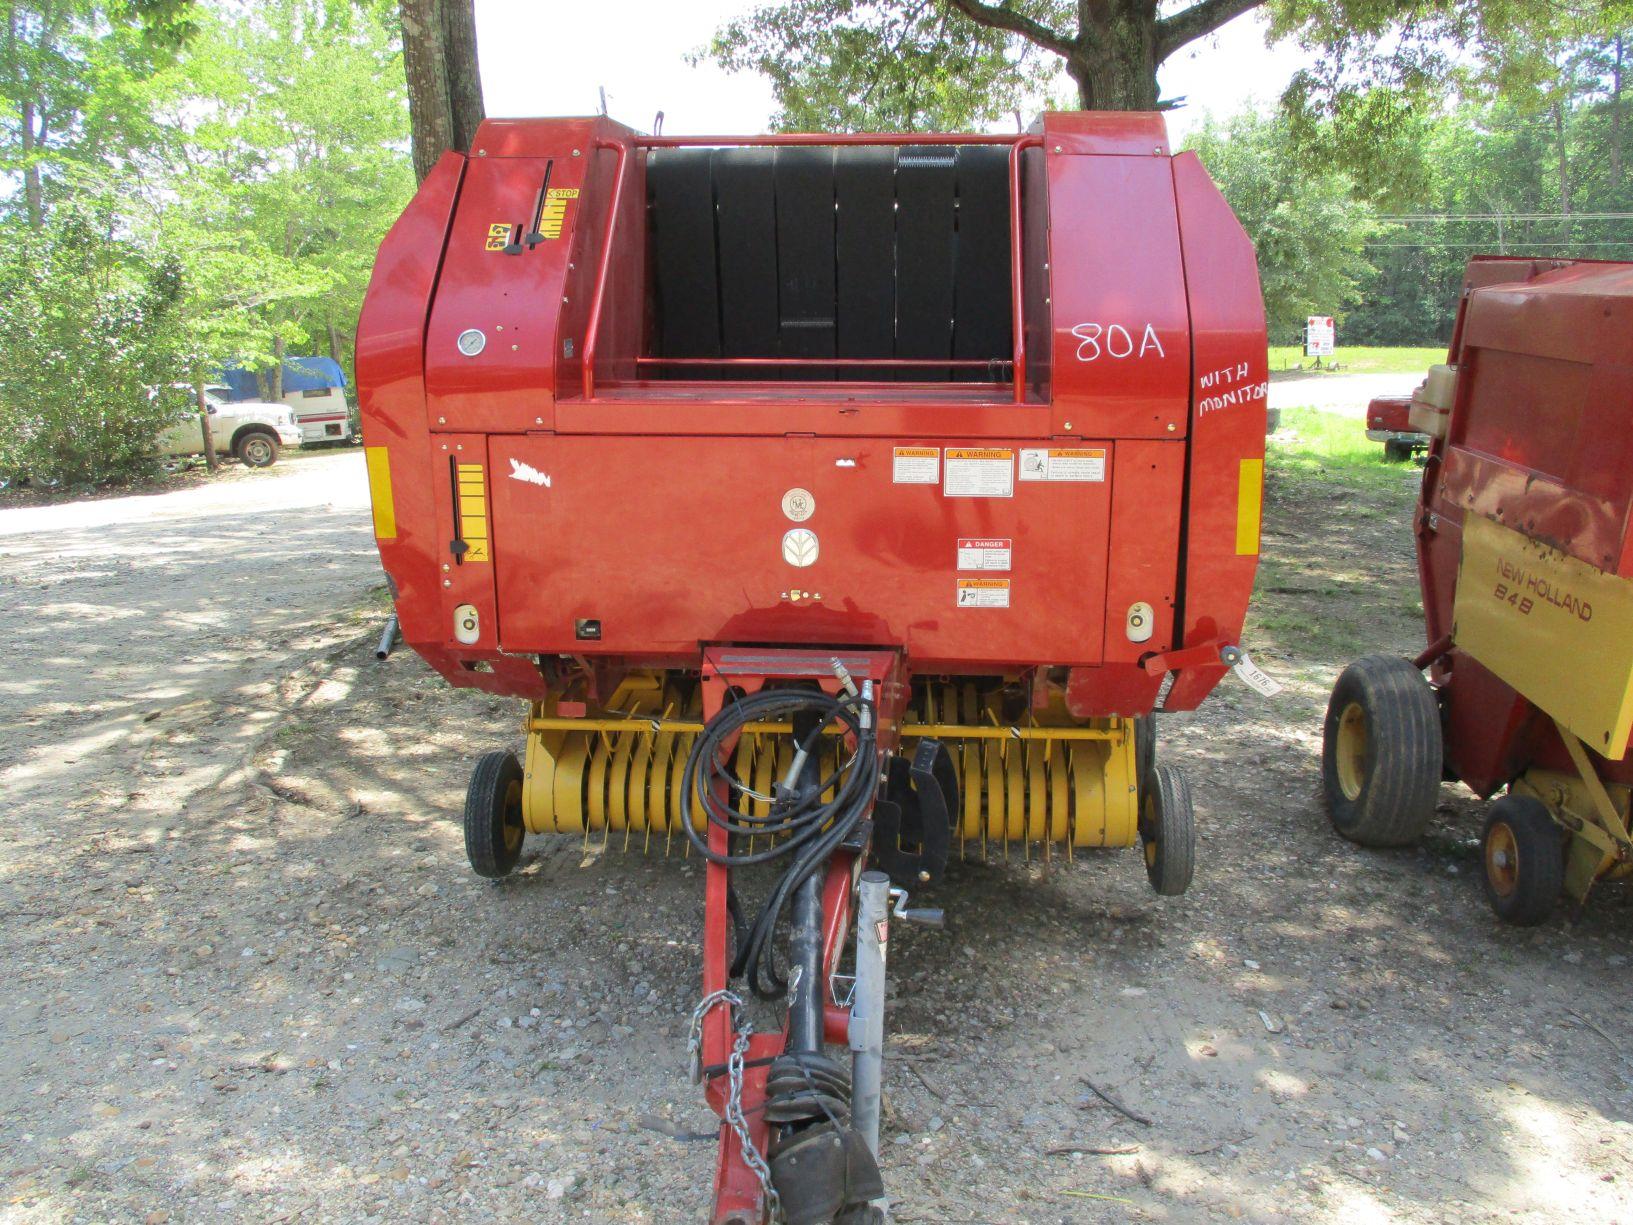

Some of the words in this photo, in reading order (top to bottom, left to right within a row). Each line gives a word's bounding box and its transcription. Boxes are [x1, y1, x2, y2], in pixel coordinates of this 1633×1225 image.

[1072, 323, 1164, 361] 80A
[1200, 362, 1248, 388] WITH
[1200, 381, 1268, 416] MONITOR
[1497, 557, 1525, 585] NEW
[1526, 574, 1592, 622] HOLLAND
